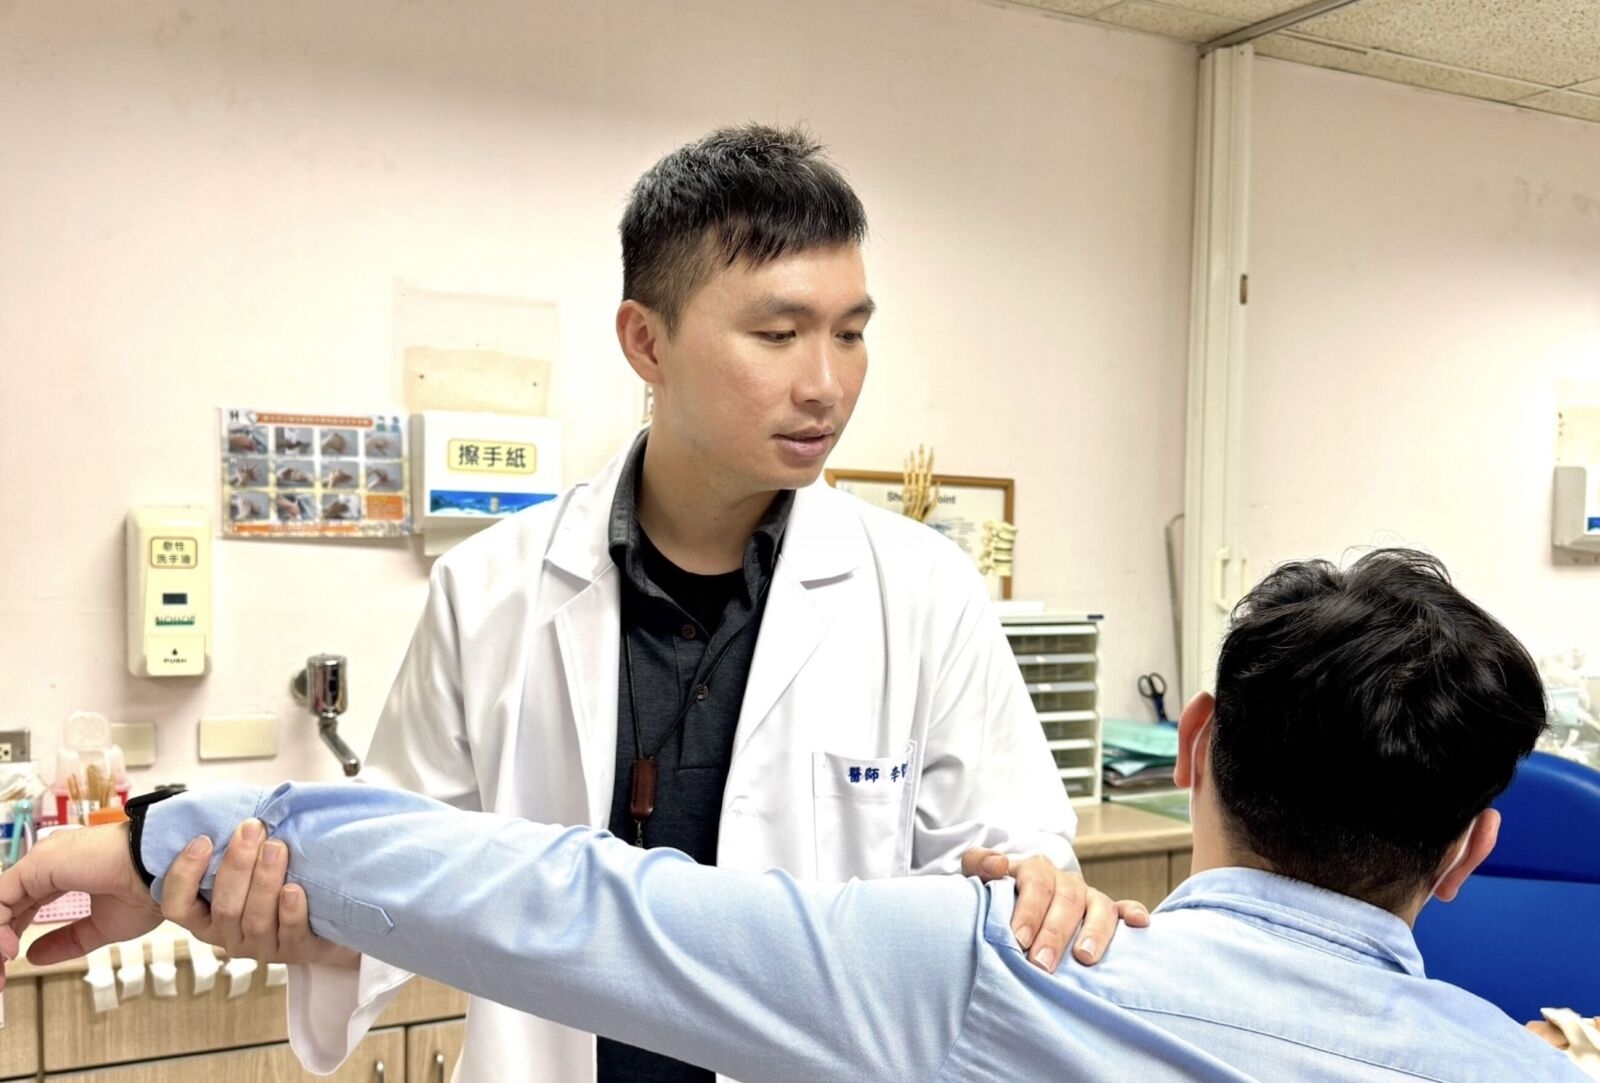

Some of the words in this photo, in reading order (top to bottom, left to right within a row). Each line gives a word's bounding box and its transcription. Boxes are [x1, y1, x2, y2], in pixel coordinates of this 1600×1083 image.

[458, 444, 526, 468] 擦手紙
[936, 495, 956, 505] oint
[848, 766, 880, 783] 醫師
